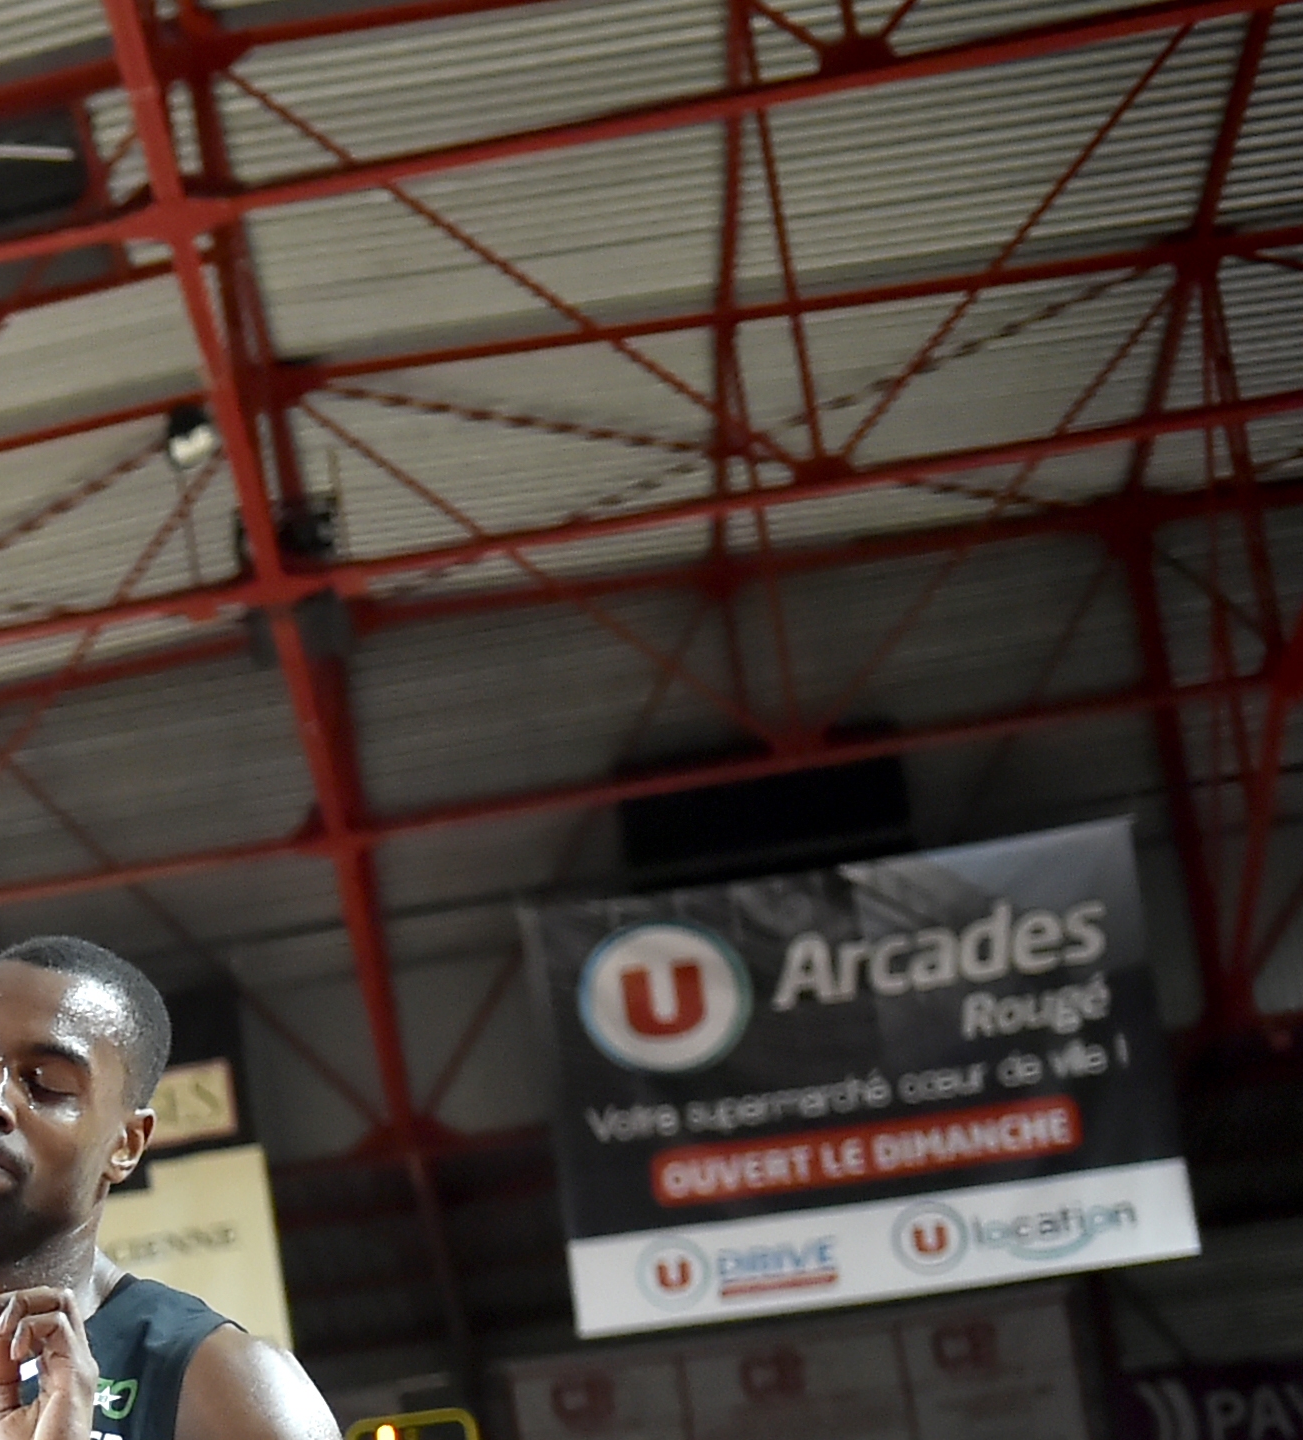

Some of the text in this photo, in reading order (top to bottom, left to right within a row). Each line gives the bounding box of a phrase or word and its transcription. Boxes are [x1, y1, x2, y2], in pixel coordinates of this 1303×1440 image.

[620, 957, 704, 1038] U
[773, 900, 1106, 1012] Arcades
[590, 1099, 679, 1142] Votre
[687, 1070, 891, 1133] supermarché
[997, 1050, 1043, 1087] de
[1049, 1039, 1109, 1079] ville
[662, 1109, 1074, 1199] OUVERT LE DIMANCHE
[656, 1257, 691, 1291] U
[909, 1221, 948, 1256] U
